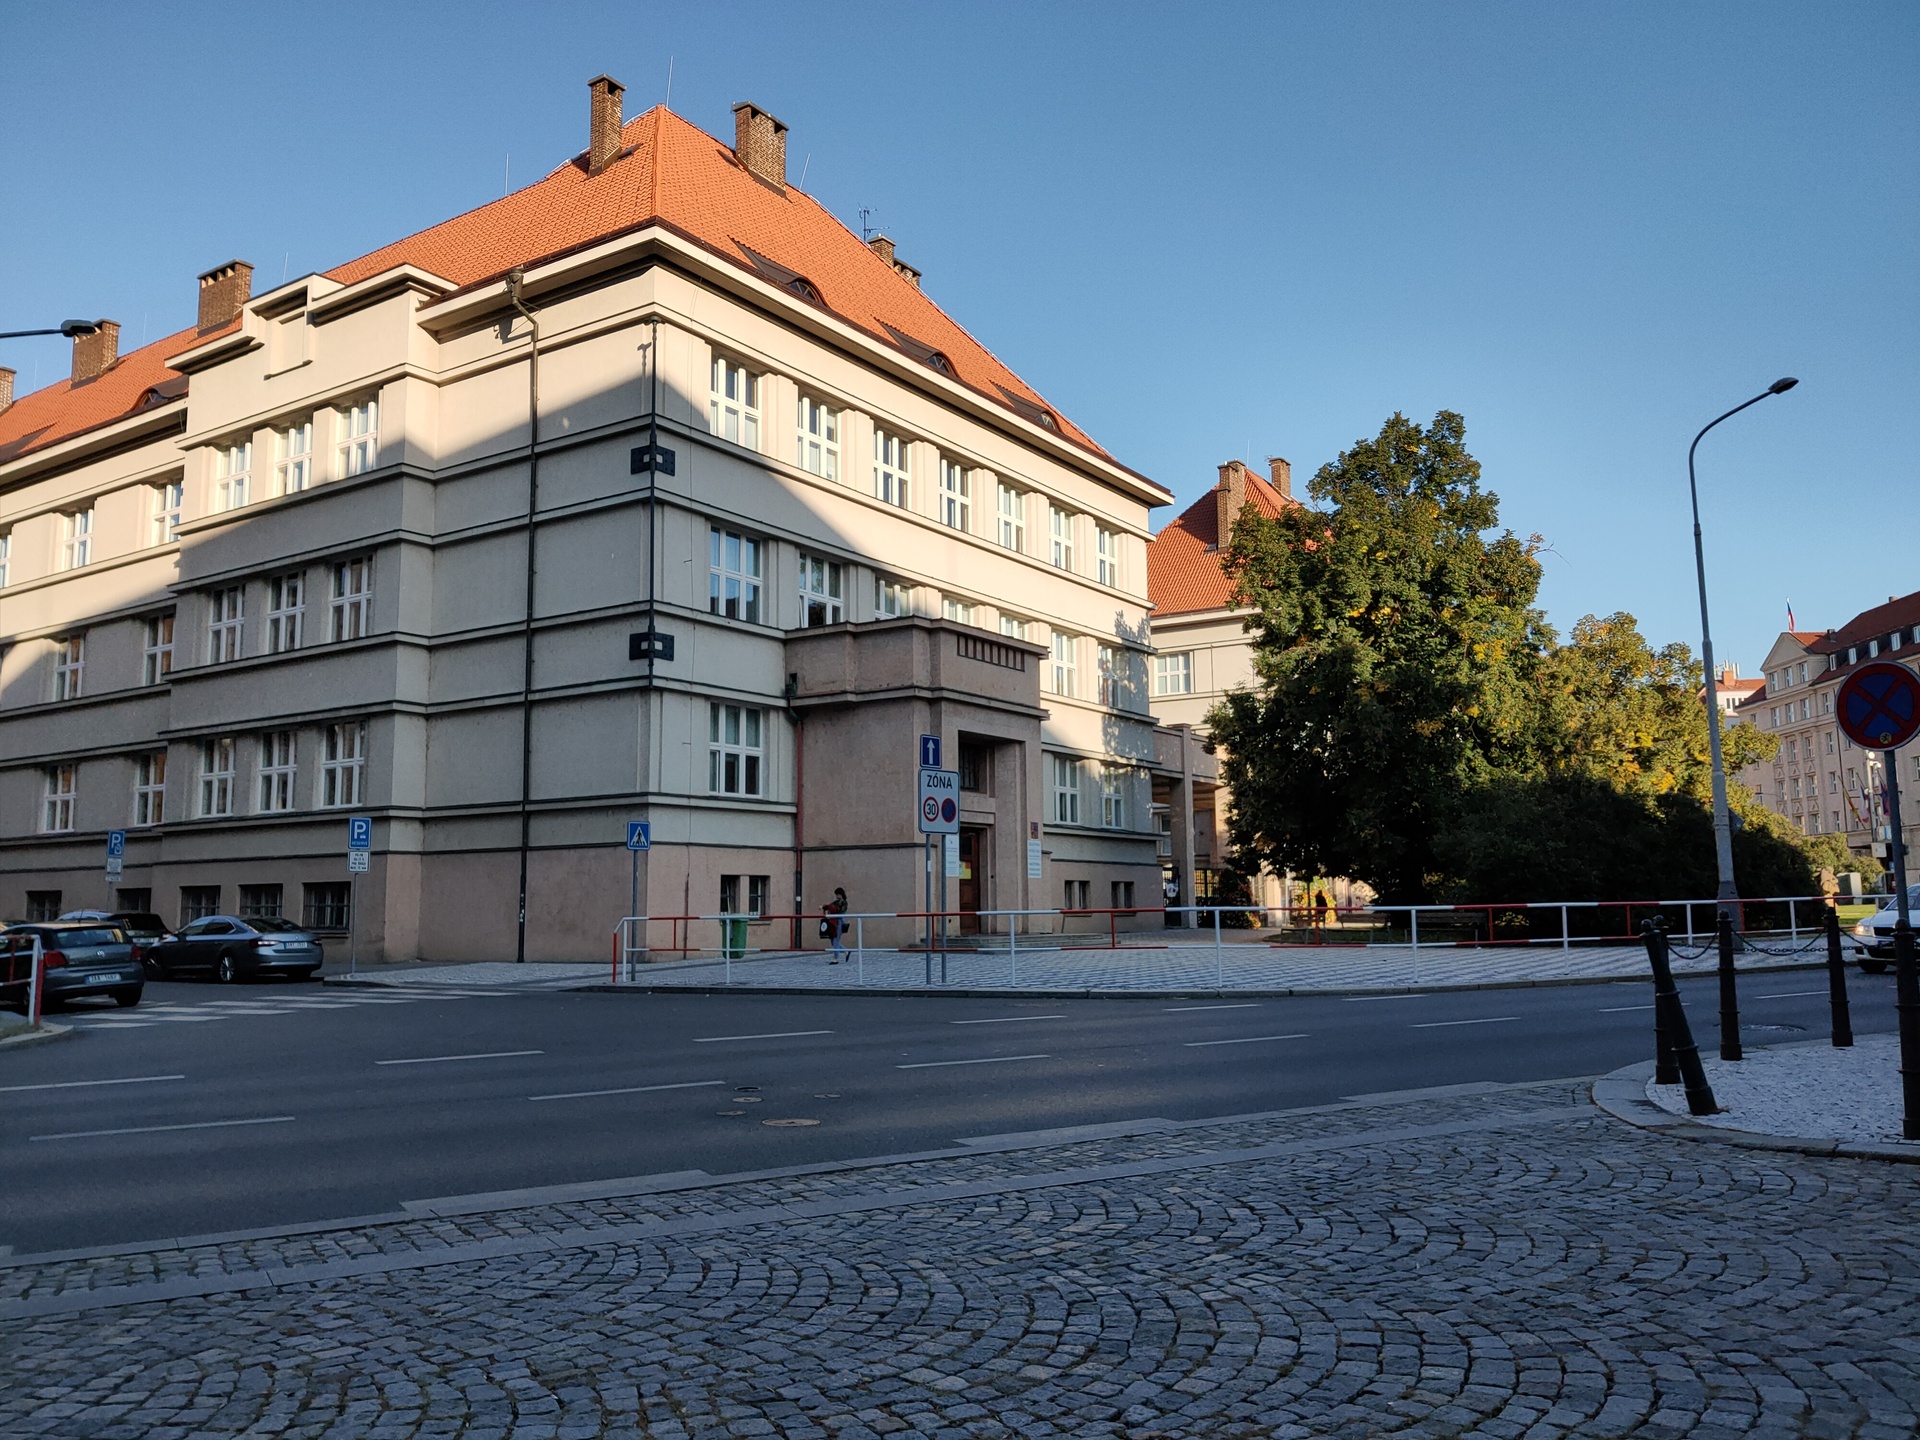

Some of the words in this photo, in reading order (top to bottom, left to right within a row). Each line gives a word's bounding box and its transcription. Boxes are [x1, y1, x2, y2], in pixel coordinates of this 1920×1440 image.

[927, 773, 952, 789] ZÓNA
[926, 803, 936, 815] 30
[354, 821, 367, 839] P
[111, 833, 121, 848] P
